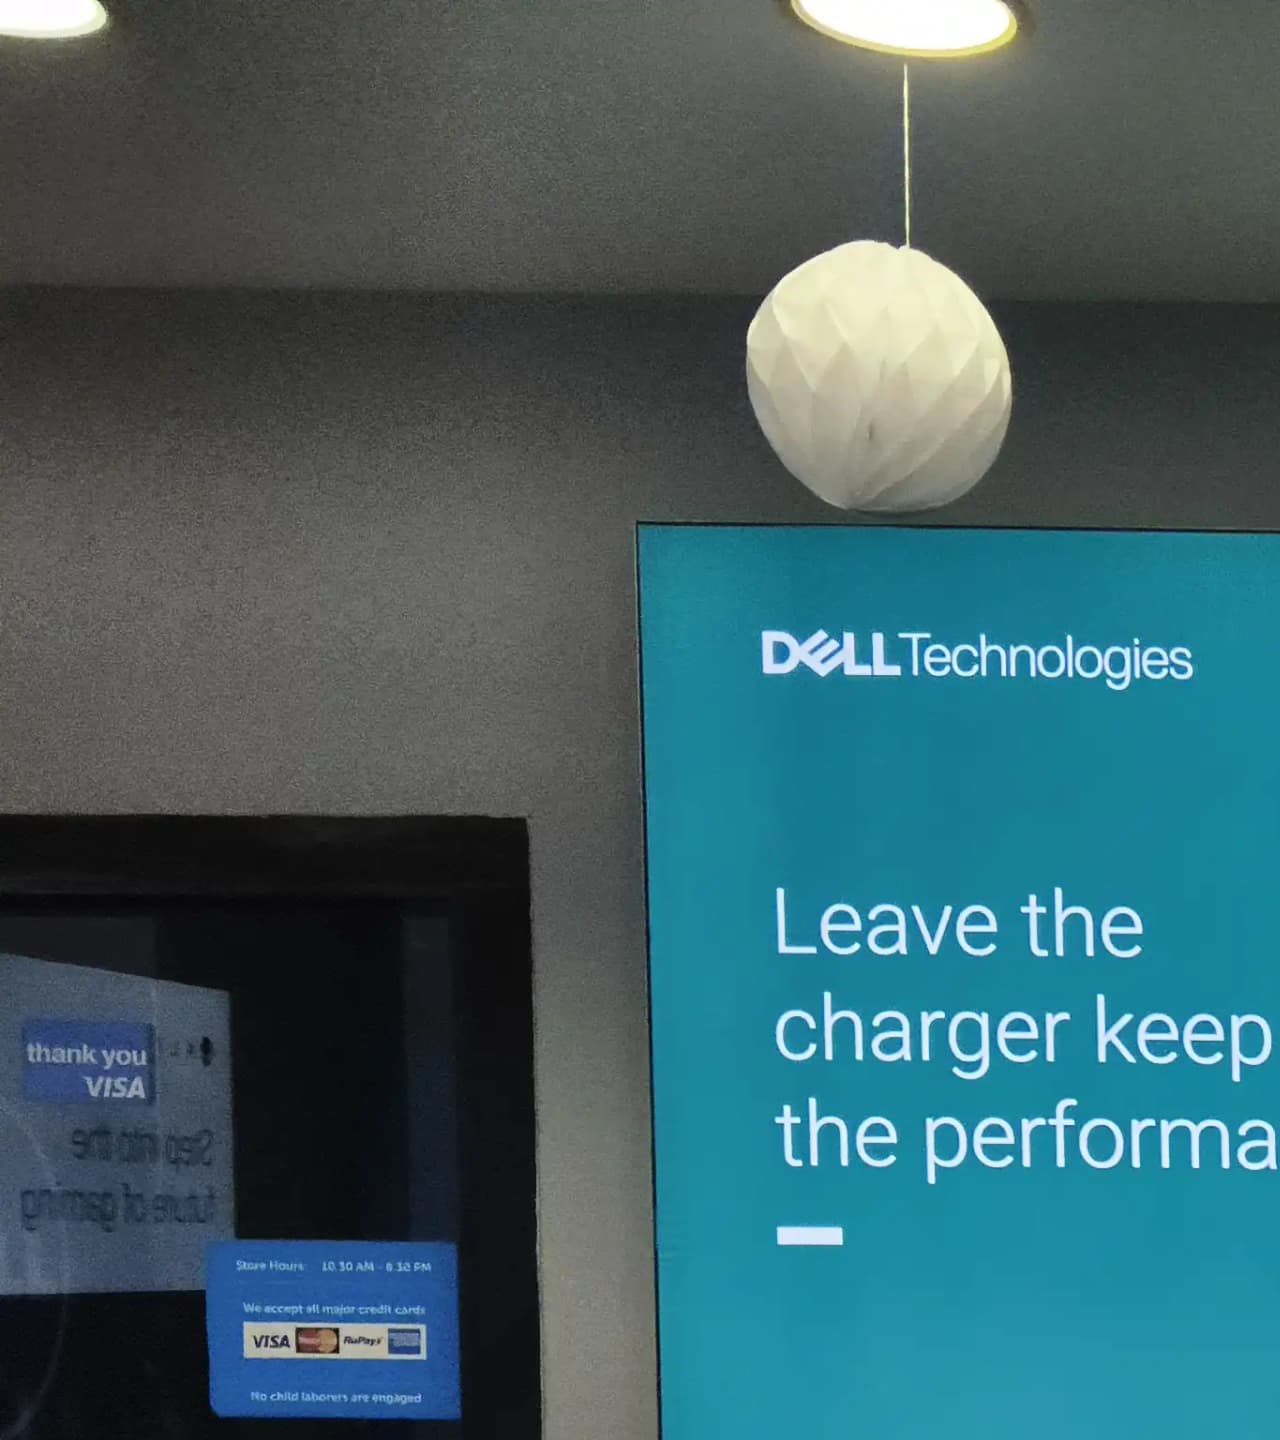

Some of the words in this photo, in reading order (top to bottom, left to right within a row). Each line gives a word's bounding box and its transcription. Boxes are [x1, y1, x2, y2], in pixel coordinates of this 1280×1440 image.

[762, 630, 901, 676] DELL
[899, 633, 1193, 690] Technologies
[777, 888, 997, 956] Leave
[1021, 887, 1143, 957] the
[776, 992, 1070, 1079] charger
[1097, 994, 1271, 1082] keep
[27, 1042, 98, 1064] thank
[102, 1049, 148, 1070] you
[83, 1076, 146, 1099] VISA
[775, 1098, 897, 1167] the
[236, 1260, 267, 1272] Store
[355, 1261, 376, 1273] AM
[413, 1262, 432, 1273] PM
[242, 1302, 262, 1314] We
[264, 1304, 304, 1317] accept
[306, 1304, 320, 1315] all
[322, 1304, 355, 1318] major
[357, 1303, 392, 1315] credit
[394, 1304, 426, 1316] cards
[252, 1334, 291, 1349] VISA
[250, 1391, 267, 1401] No
[269, 1391, 299, 1402] child
[301, 1392, 348, 1403] laborers
[351, 1394, 369, 1404] are
[371, 1393, 422, 1406] engaged
